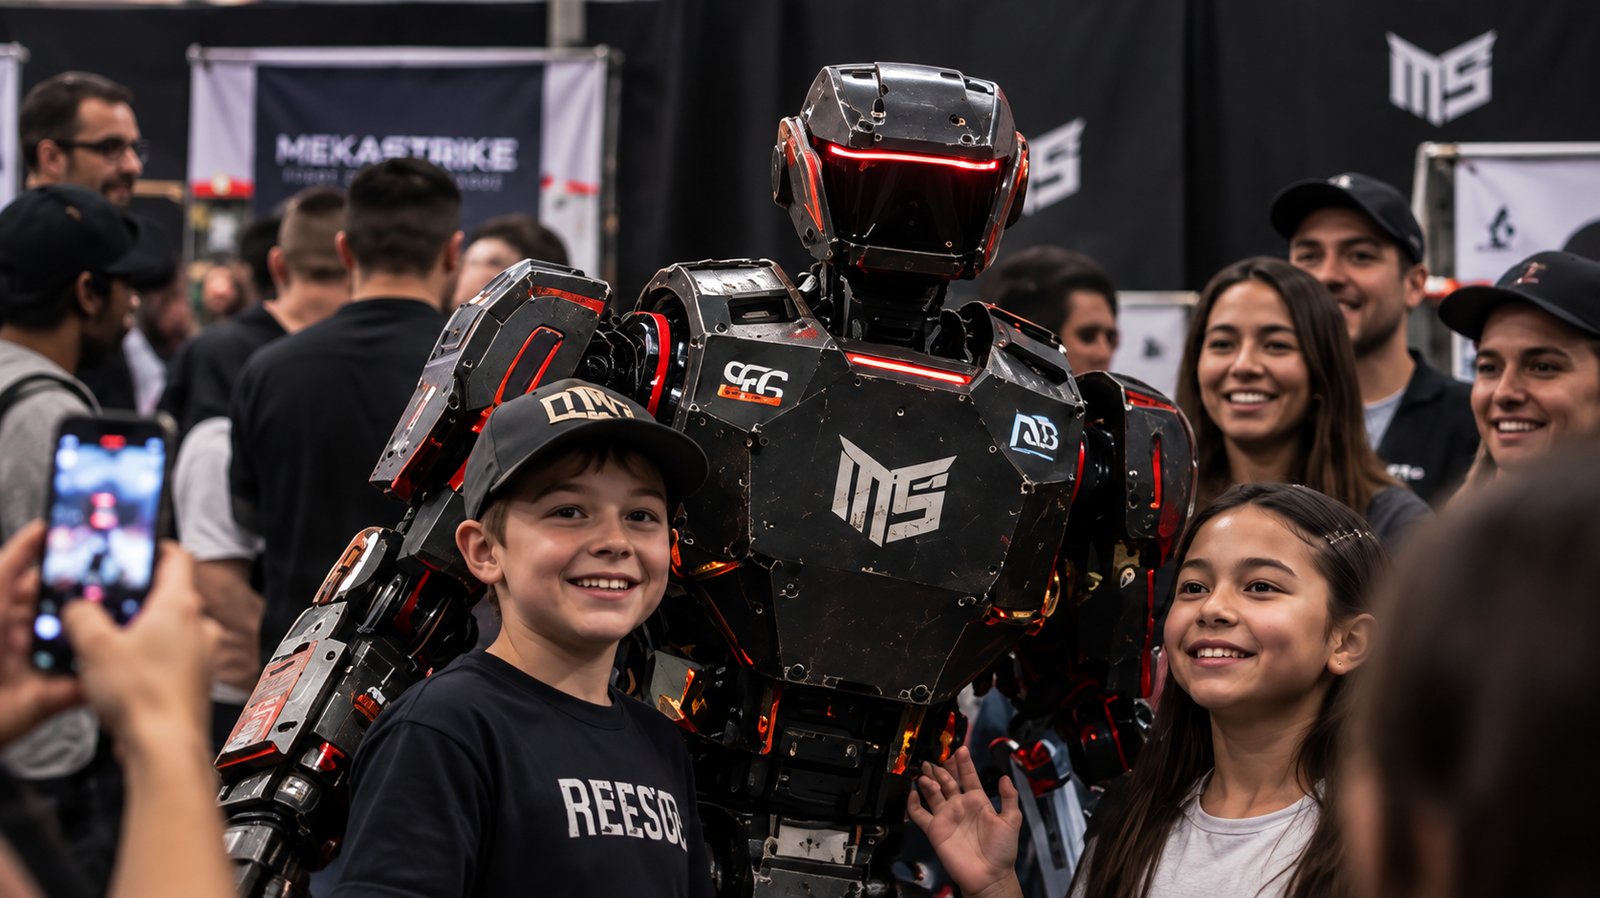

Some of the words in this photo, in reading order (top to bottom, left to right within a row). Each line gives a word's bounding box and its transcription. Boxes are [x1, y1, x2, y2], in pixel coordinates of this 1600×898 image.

[1386, 30, 1497, 127] MS
[276, 134, 518, 171] MEKASTRIKE
[1022, 118, 1086, 216] S
[831, 434, 958, 547] MS
